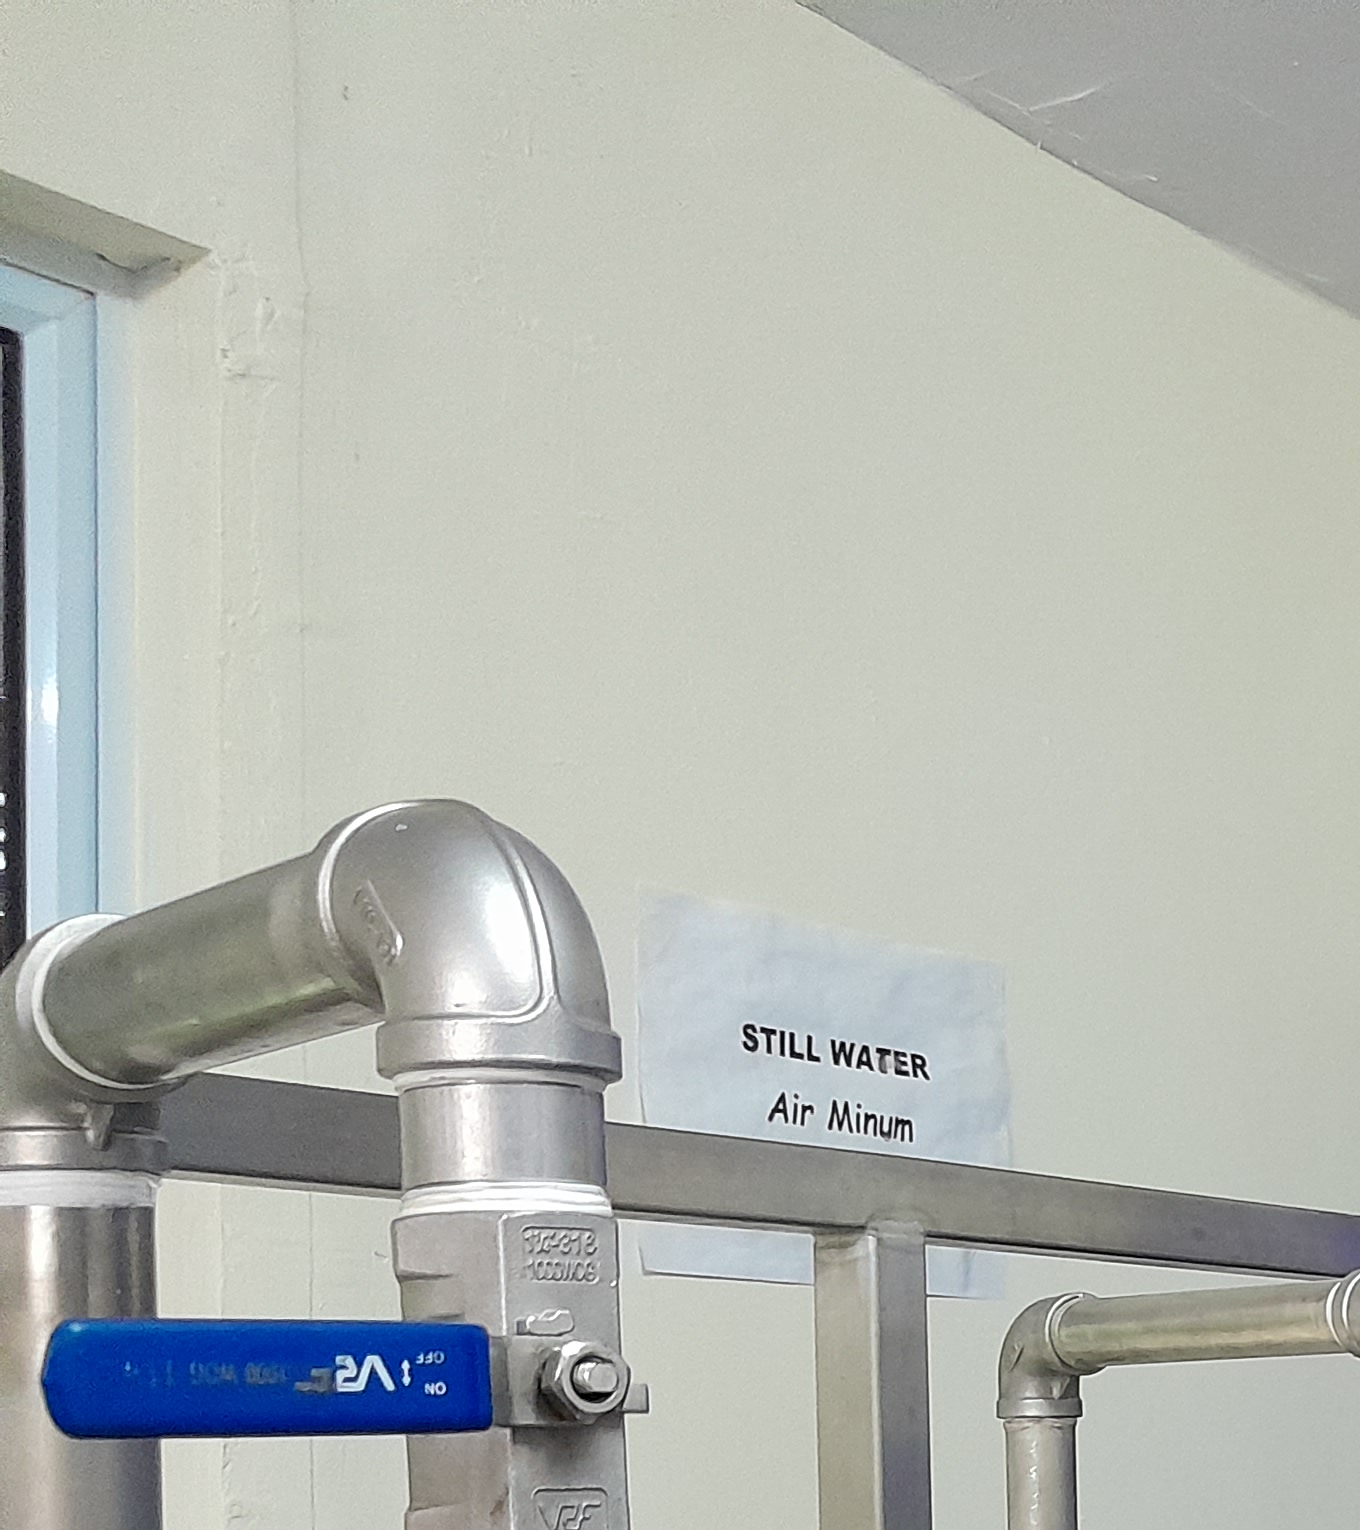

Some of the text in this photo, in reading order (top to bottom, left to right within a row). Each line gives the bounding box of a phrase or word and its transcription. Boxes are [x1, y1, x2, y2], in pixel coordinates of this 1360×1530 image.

[742, 1023, 931, 1080] STILL WATER
[767, 1092, 914, 1142] Air Minum
[416, 1350, 445, 1365] OFF
[424, 1381, 447, 1395] ON
